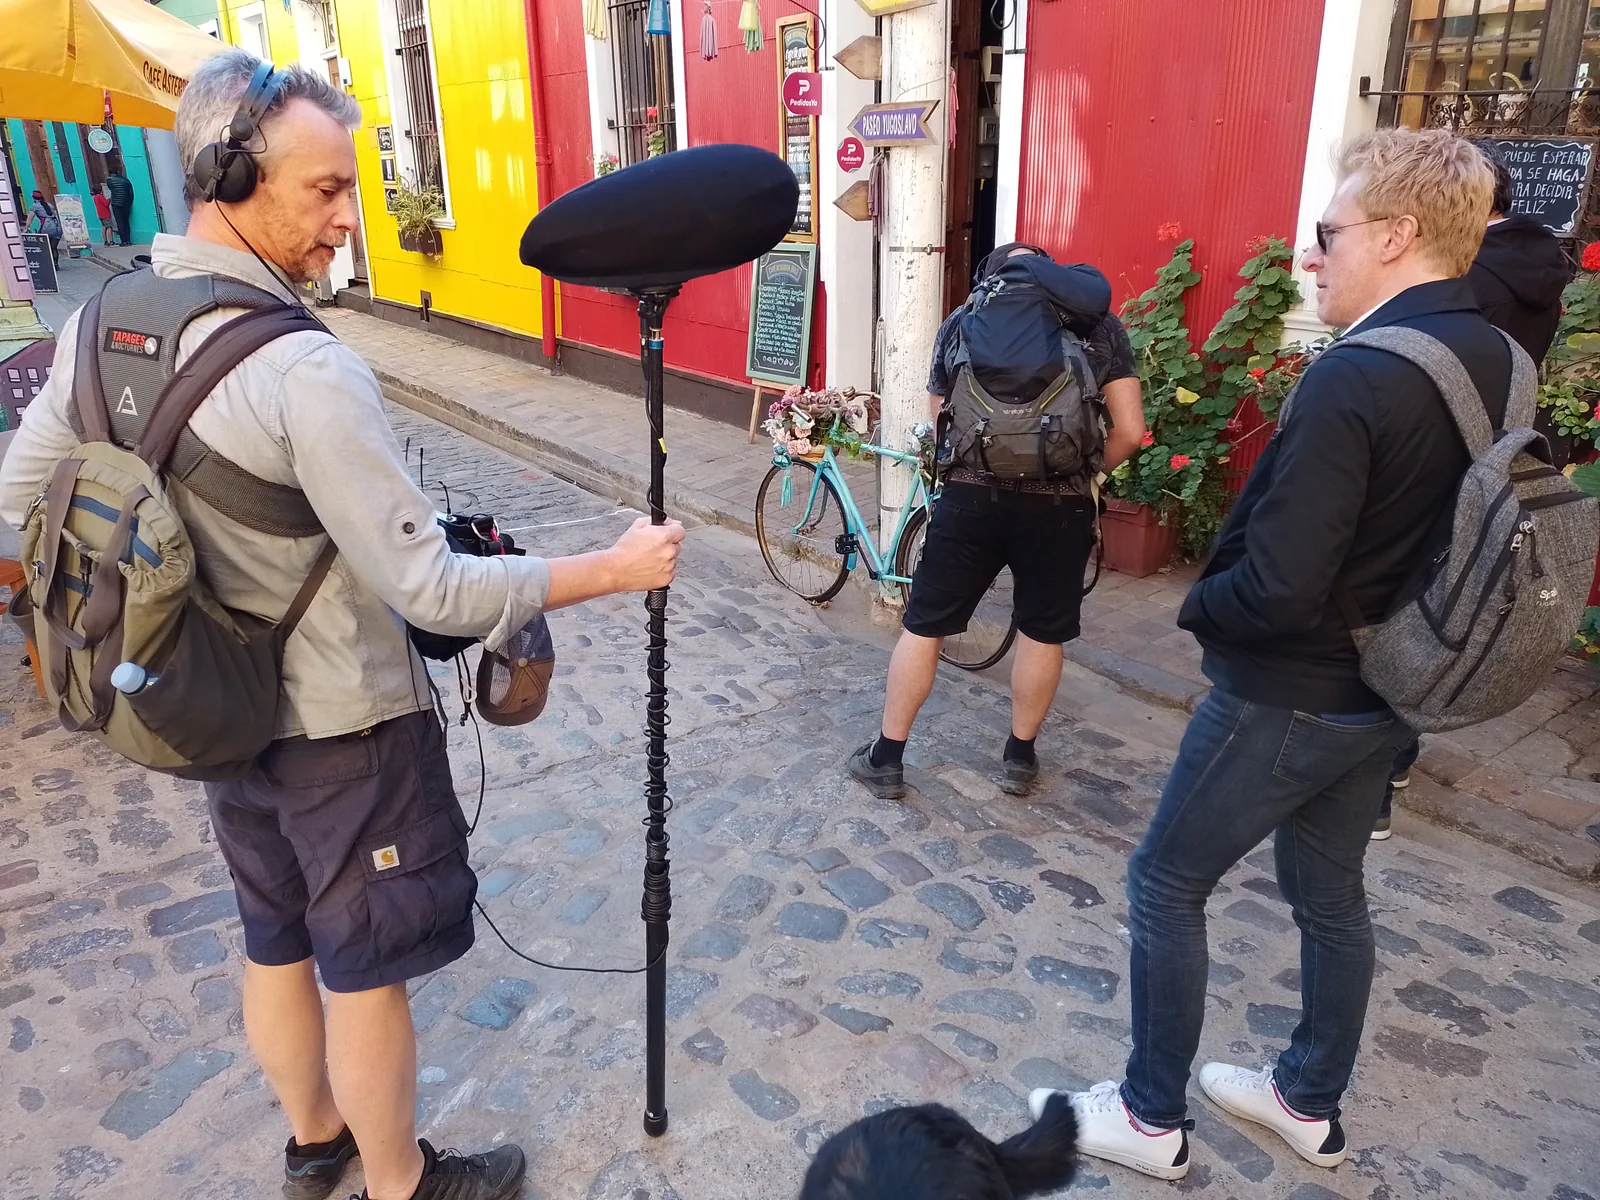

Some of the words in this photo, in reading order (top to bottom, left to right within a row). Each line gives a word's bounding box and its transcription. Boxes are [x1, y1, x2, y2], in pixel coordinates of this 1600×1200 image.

[790, 98, 818, 107] PedidosYa
[863, 114, 880, 136] PASEO
[882, 113, 917, 135] YUGOSLAVO
[1504, 150, 1537, 163] PUEDE
[1542, 151, 1589, 166] ESPERAR
[1526, 166, 1543, 180] SE
[1547, 168, 1580, 183] HAGA
[113, 330, 146, 346] TAPAGES
